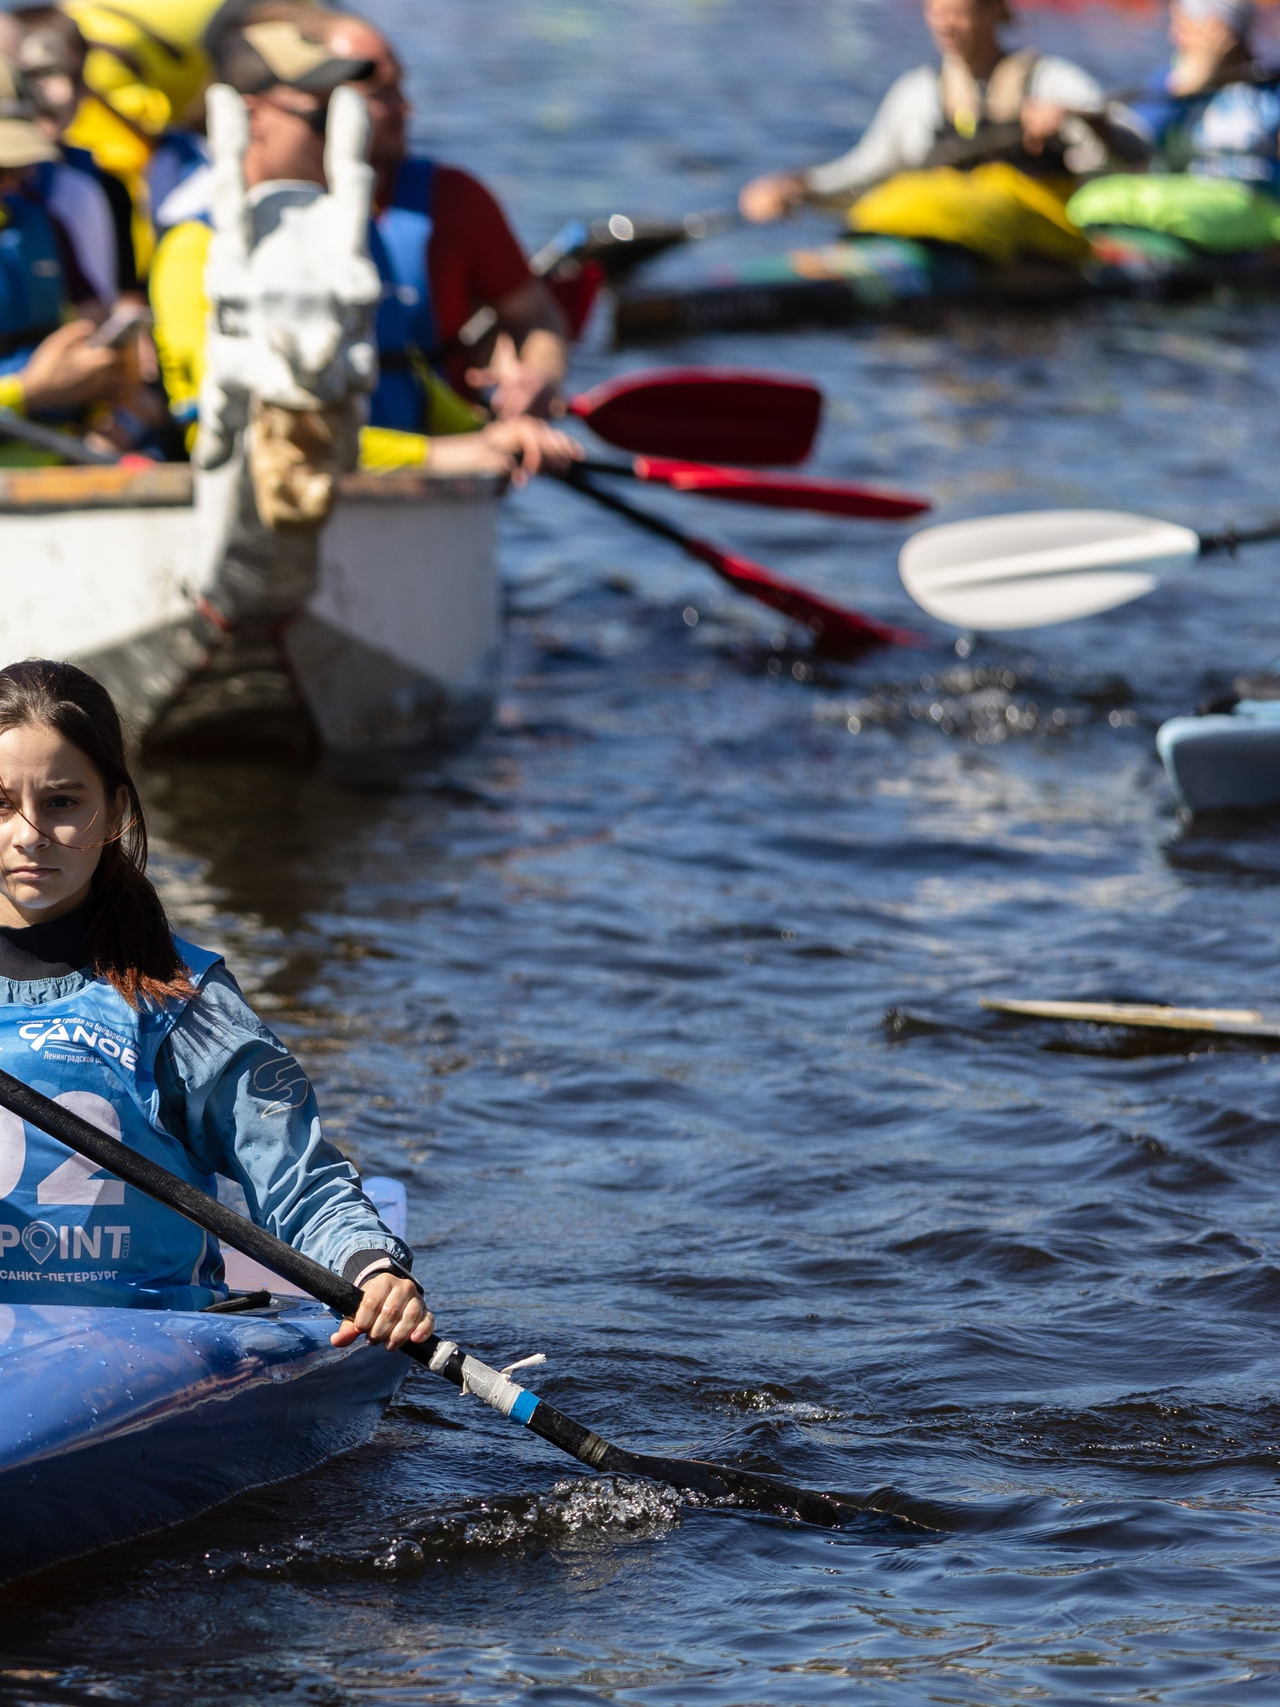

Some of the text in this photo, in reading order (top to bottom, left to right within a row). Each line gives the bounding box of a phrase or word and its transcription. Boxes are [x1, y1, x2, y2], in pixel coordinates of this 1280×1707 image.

[86, 1021, 94, 1029] на
[19, 1018, 139, 1072] CANOE
[122, 1234, 131, 1258] CLUB
